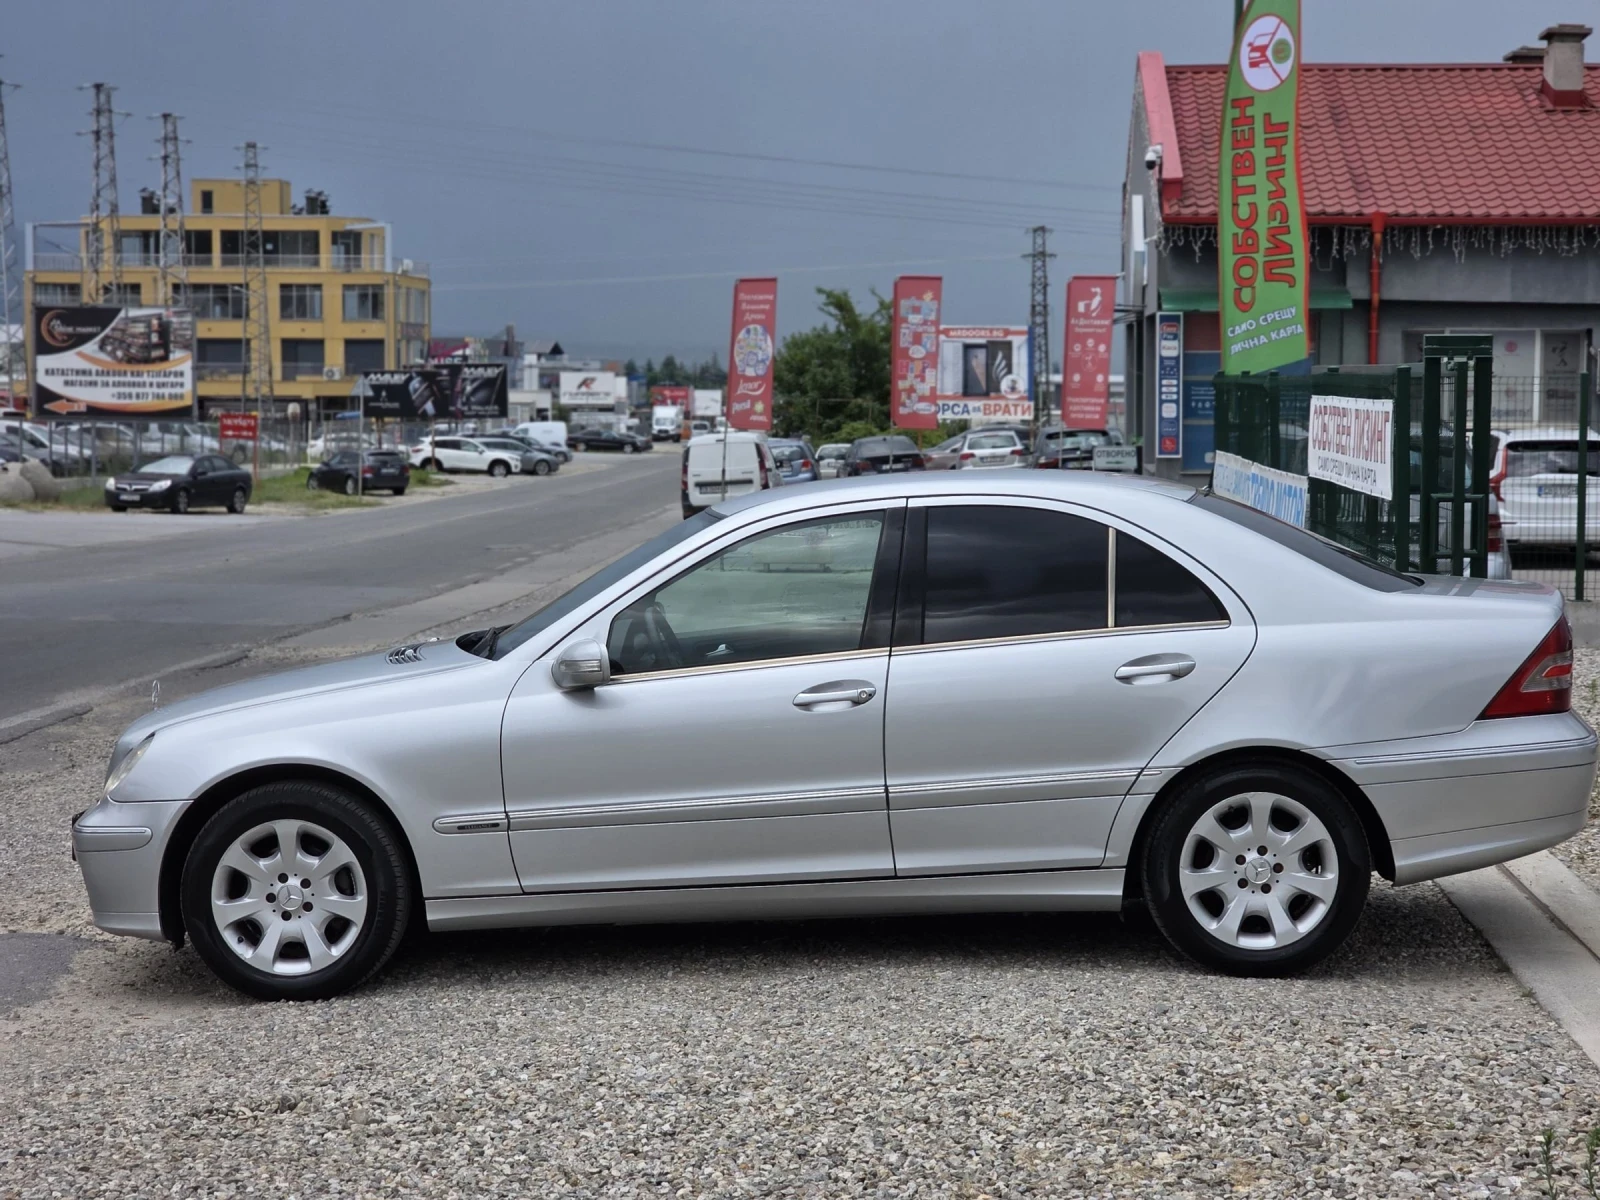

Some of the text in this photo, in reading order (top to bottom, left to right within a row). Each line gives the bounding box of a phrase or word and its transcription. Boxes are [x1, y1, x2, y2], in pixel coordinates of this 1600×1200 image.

[1231, 96, 1259, 313] СОБСТВЕН
[1263, 112, 1297, 289] ЛИЗИНГ
[1227, 306, 1297, 337] САМО СРЕЩУ
[1230, 324, 1304, 355] ЛИЧНА КАРТА
[100, 380, 110, 388] ЗА
[155, 381, 185, 389] ЦИГАРИ
[983, 403, 1032, 416] ВРАТИ
[1312, 404, 1390, 465] СОБСТВЕН ЛИЗИНГ
[1096, 450, 1136, 458] ОТВОРЕНО
